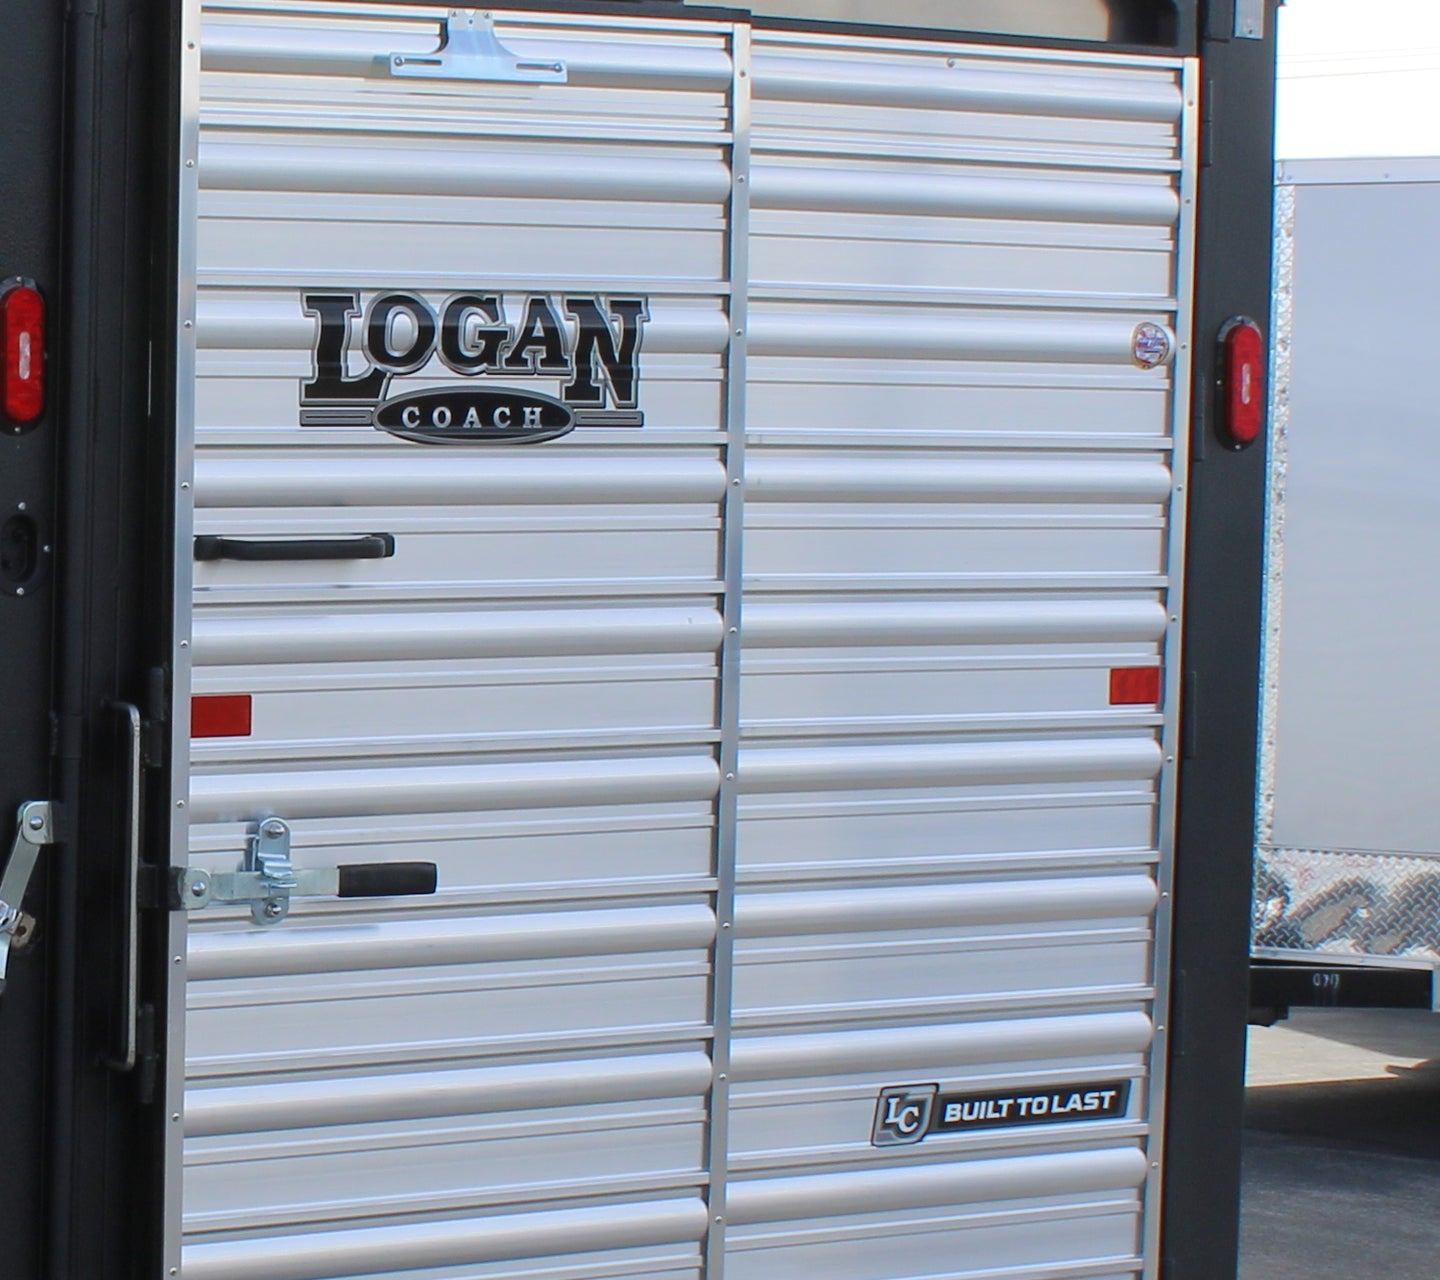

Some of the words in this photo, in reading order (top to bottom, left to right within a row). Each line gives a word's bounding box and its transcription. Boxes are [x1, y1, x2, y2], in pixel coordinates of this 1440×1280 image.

[299, 288, 651, 409] LOGAN
[401, 405, 543, 429] COACH
[884, 1096, 919, 1133] LC
[943, 1098, 1014, 1123] BUILT
[1016, 1095, 1049, 1116] TO
[1051, 1090, 1117, 1114] LAST
